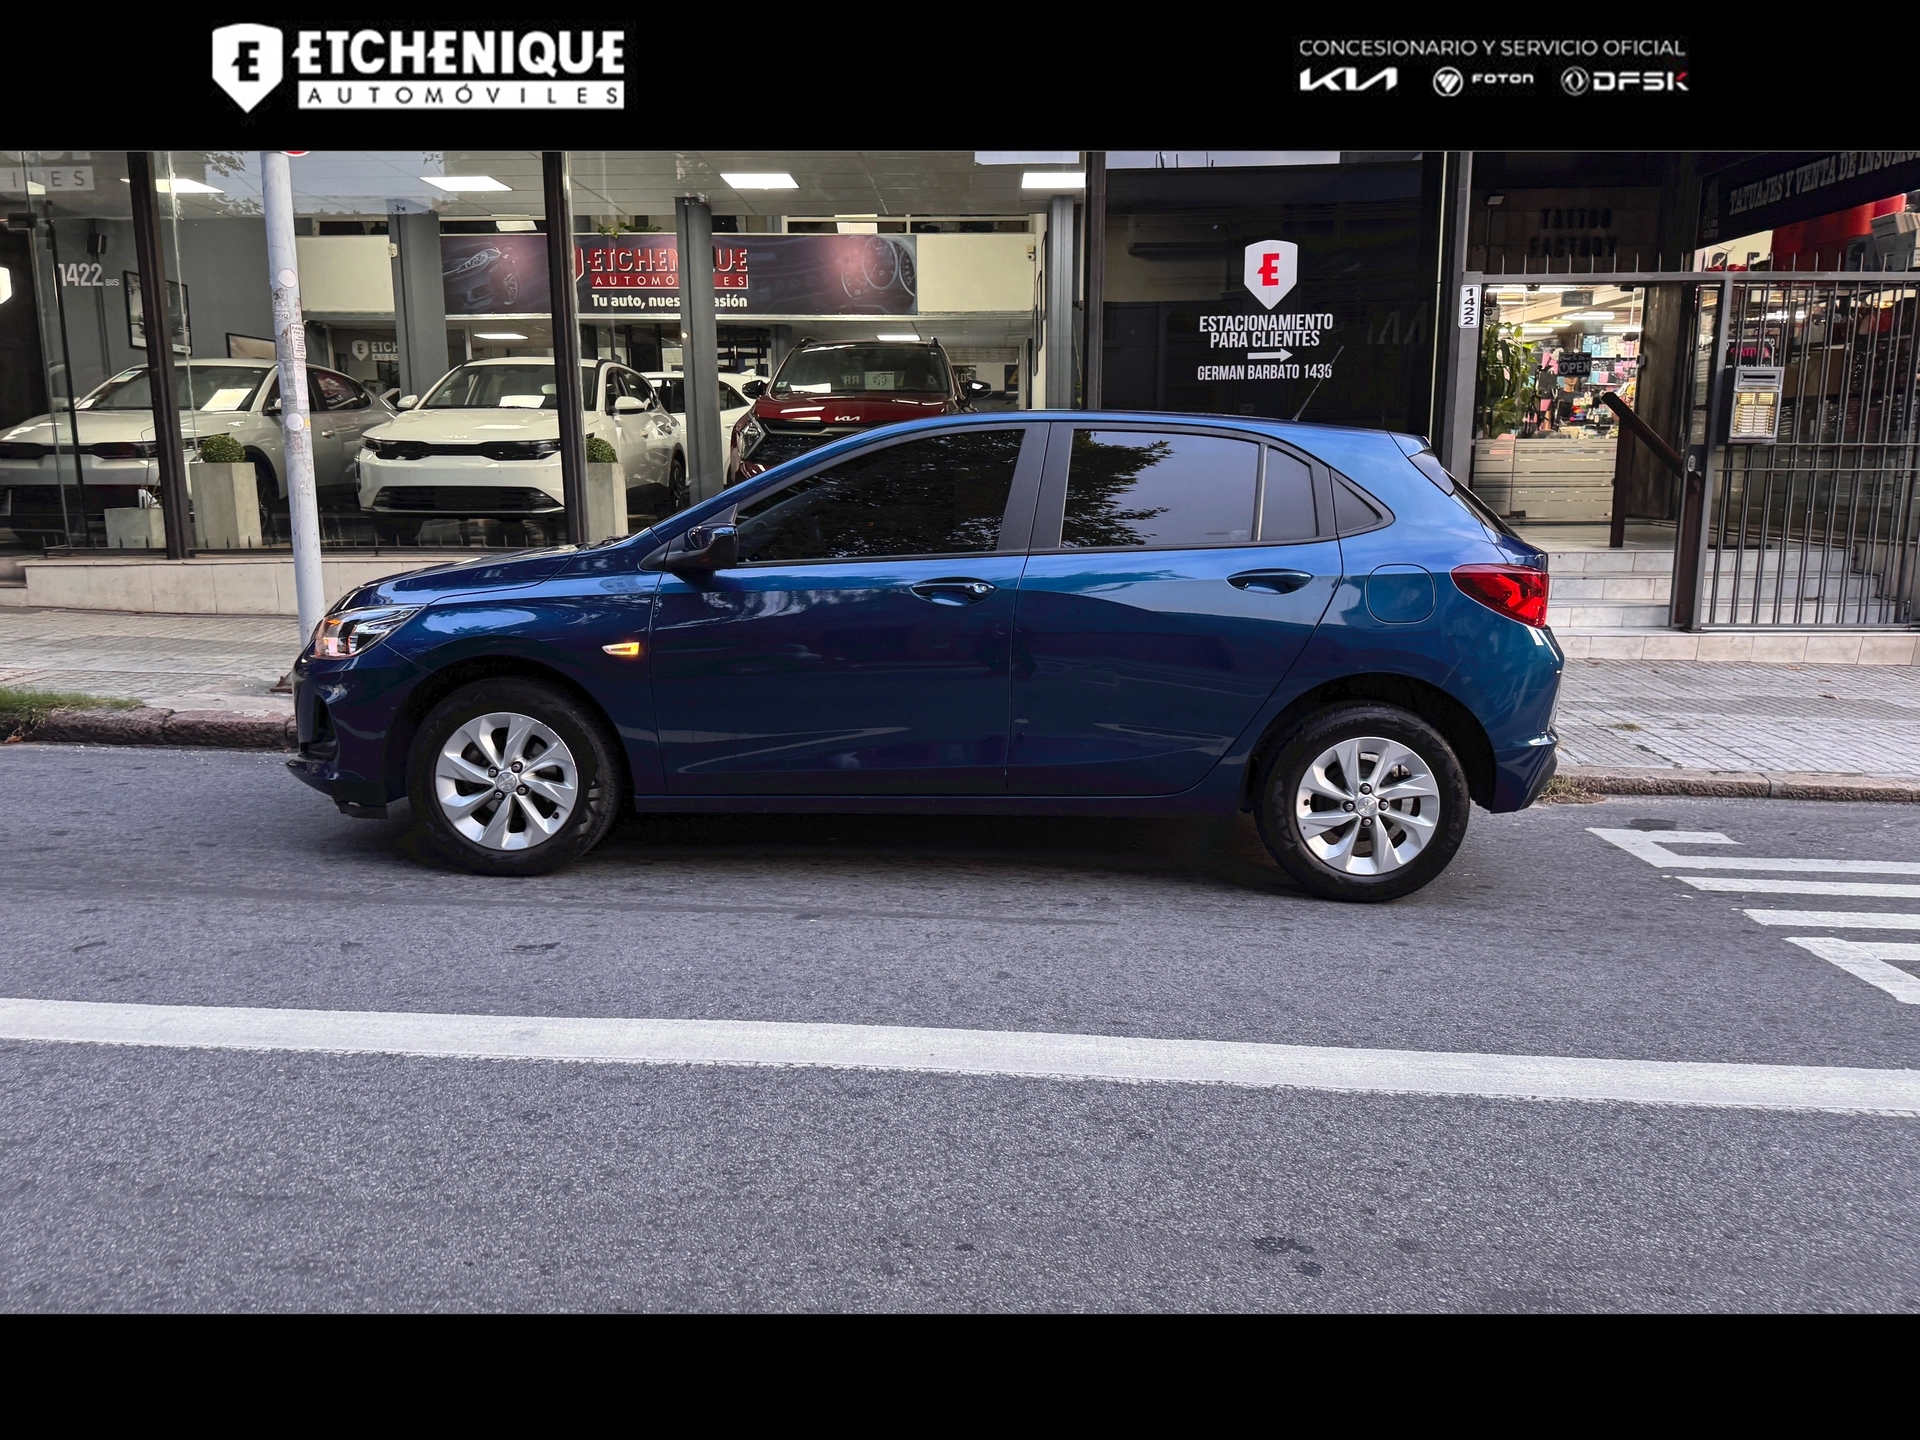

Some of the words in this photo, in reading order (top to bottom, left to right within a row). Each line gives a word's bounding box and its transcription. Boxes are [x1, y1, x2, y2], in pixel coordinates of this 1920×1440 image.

[1729, 175, 1784, 216] TATUAJES
[1785, 169, 1796, 198] Y
[1795, 154, 1837, 194] VENTA
[1837, 152, 1857, 182] DE
[58, 262, 104, 287] 1422
[105, 278, 120, 287] BIS
[591, 294, 608, 307] Tu
[611, 294, 646, 310] auto,
[1463, 287, 1476, 326] 1422
[1199, 313, 1334, 333] ESTACIONAMIENTO
[1210, 331, 1249, 348] PARA
[1252, 330, 1320, 347] CLIENTES
[1197, 365, 1245, 381] GERMAN
[1247, 364, 1300, 380] BARBATO
[1558, 361, 1590, 375] OPEN
